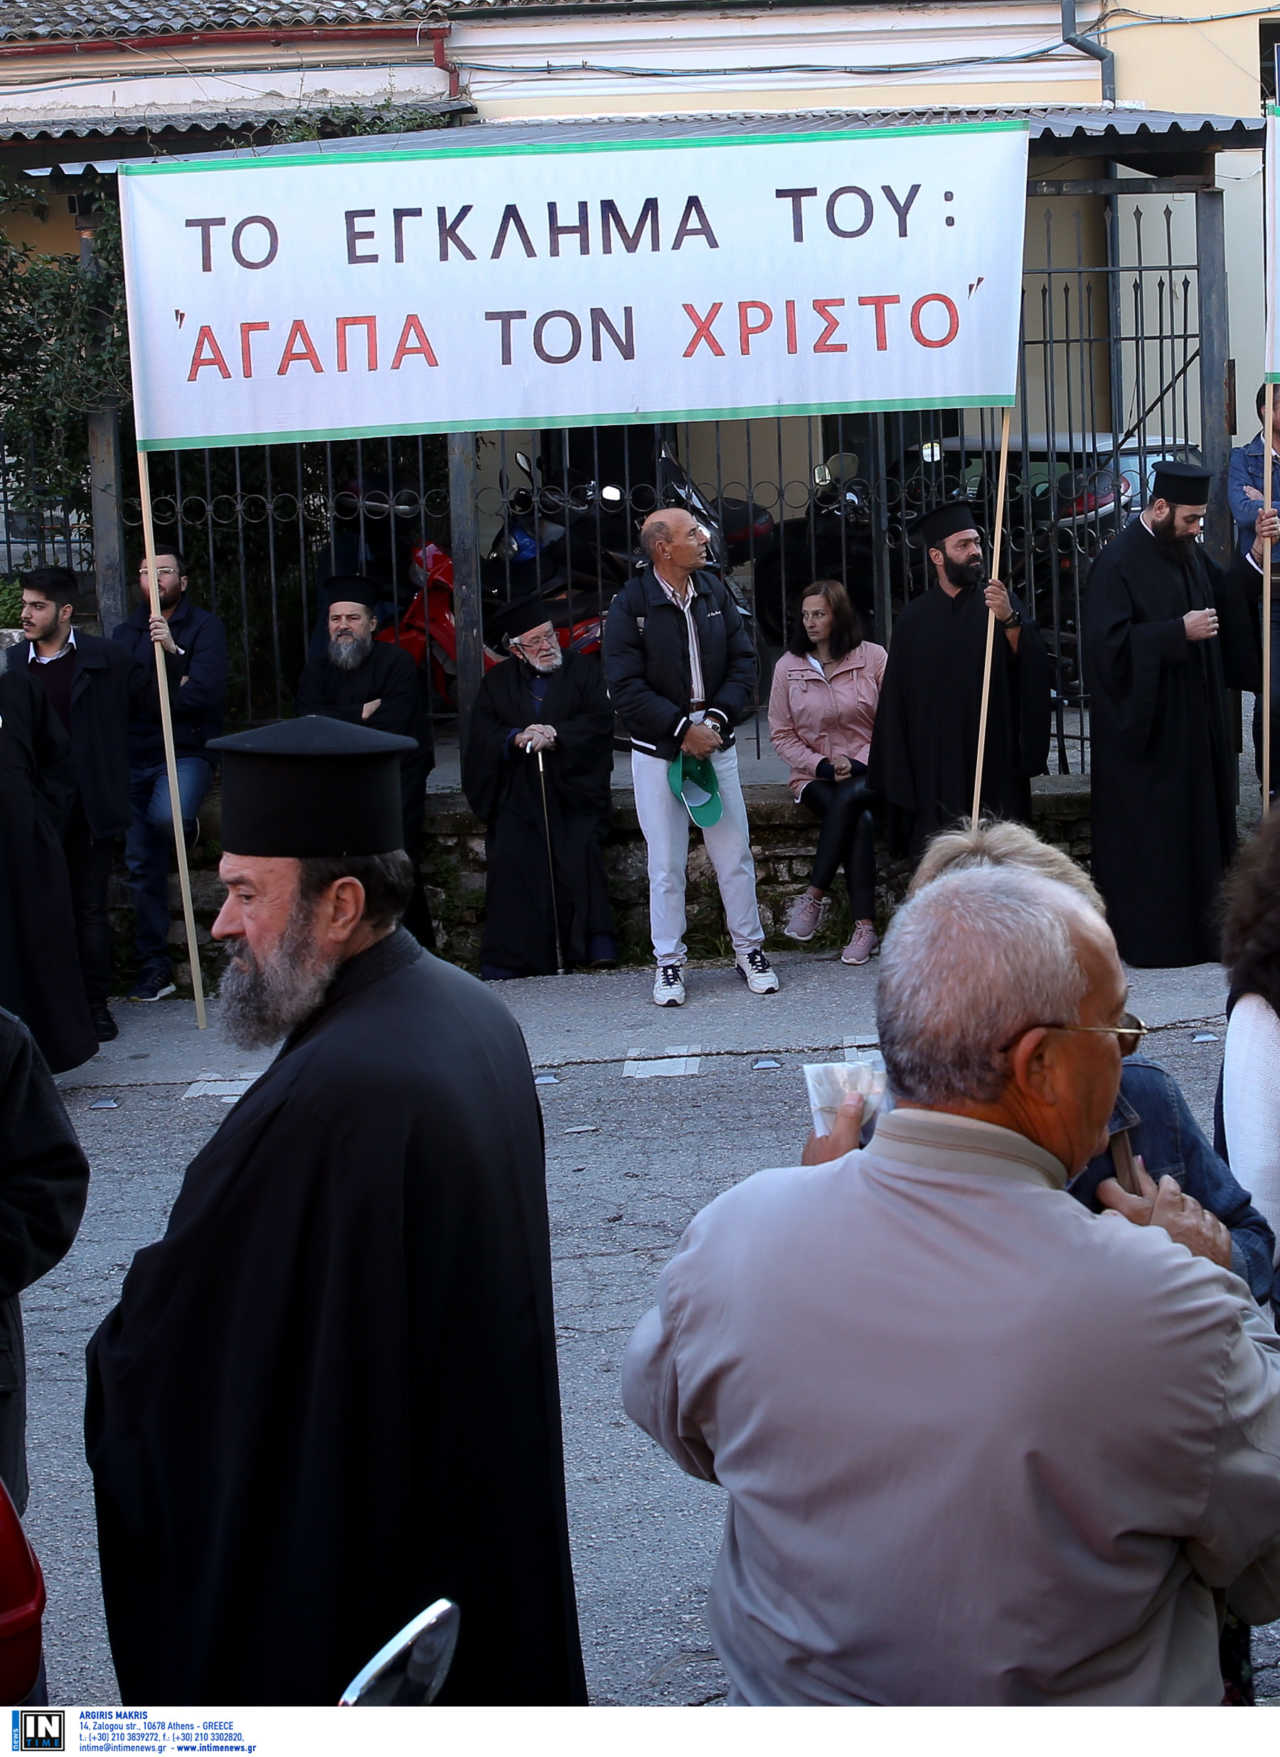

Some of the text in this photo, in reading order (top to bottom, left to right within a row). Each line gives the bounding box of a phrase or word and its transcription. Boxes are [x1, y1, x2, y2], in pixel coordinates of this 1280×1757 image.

[185, 183, 955, 272] ΤΟ ΕΓΚΛΗΜΑ ΤΟΥ:
[484, 306, 635, 366] ΤΟΝ
